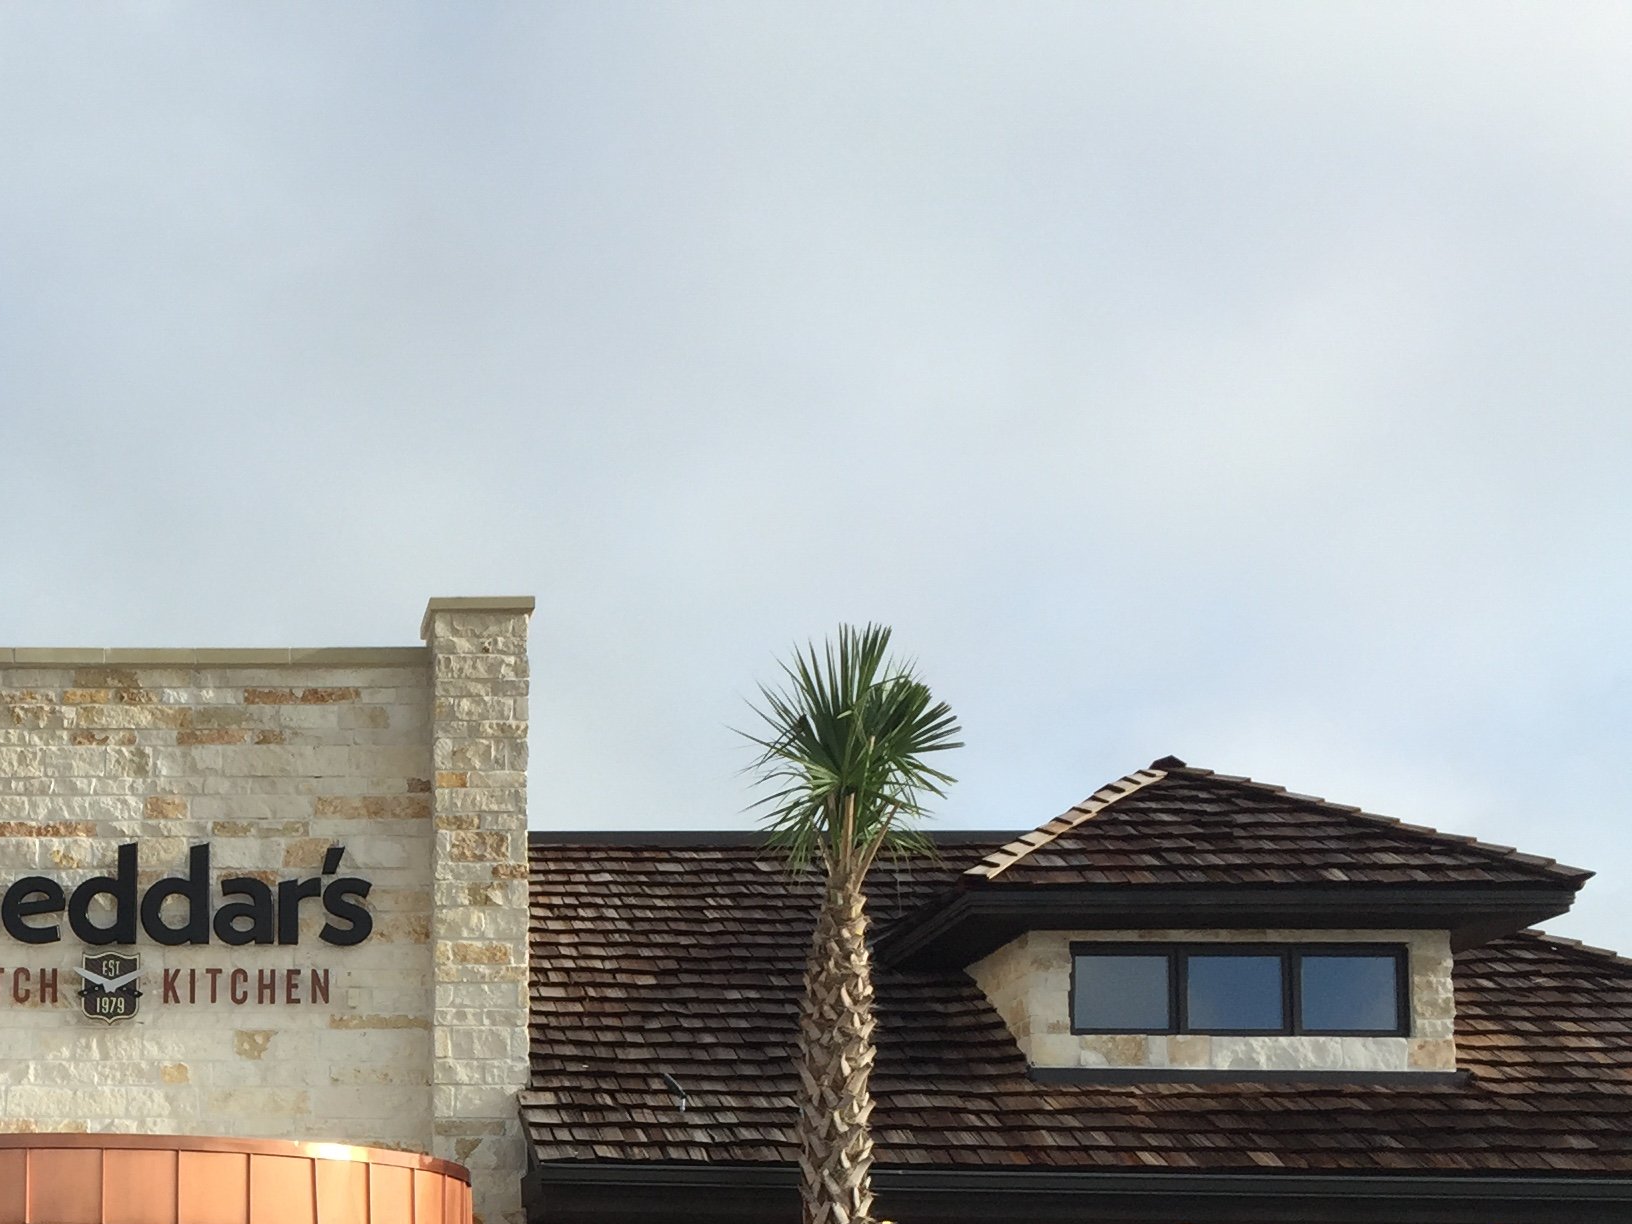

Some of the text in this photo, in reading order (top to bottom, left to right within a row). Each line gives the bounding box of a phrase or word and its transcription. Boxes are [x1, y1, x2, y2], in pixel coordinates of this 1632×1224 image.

[102, 960, 120, 977] EST
[162, 967, 330, 1005] KITCHEN
[96, 997, 125, 1014] 1979
